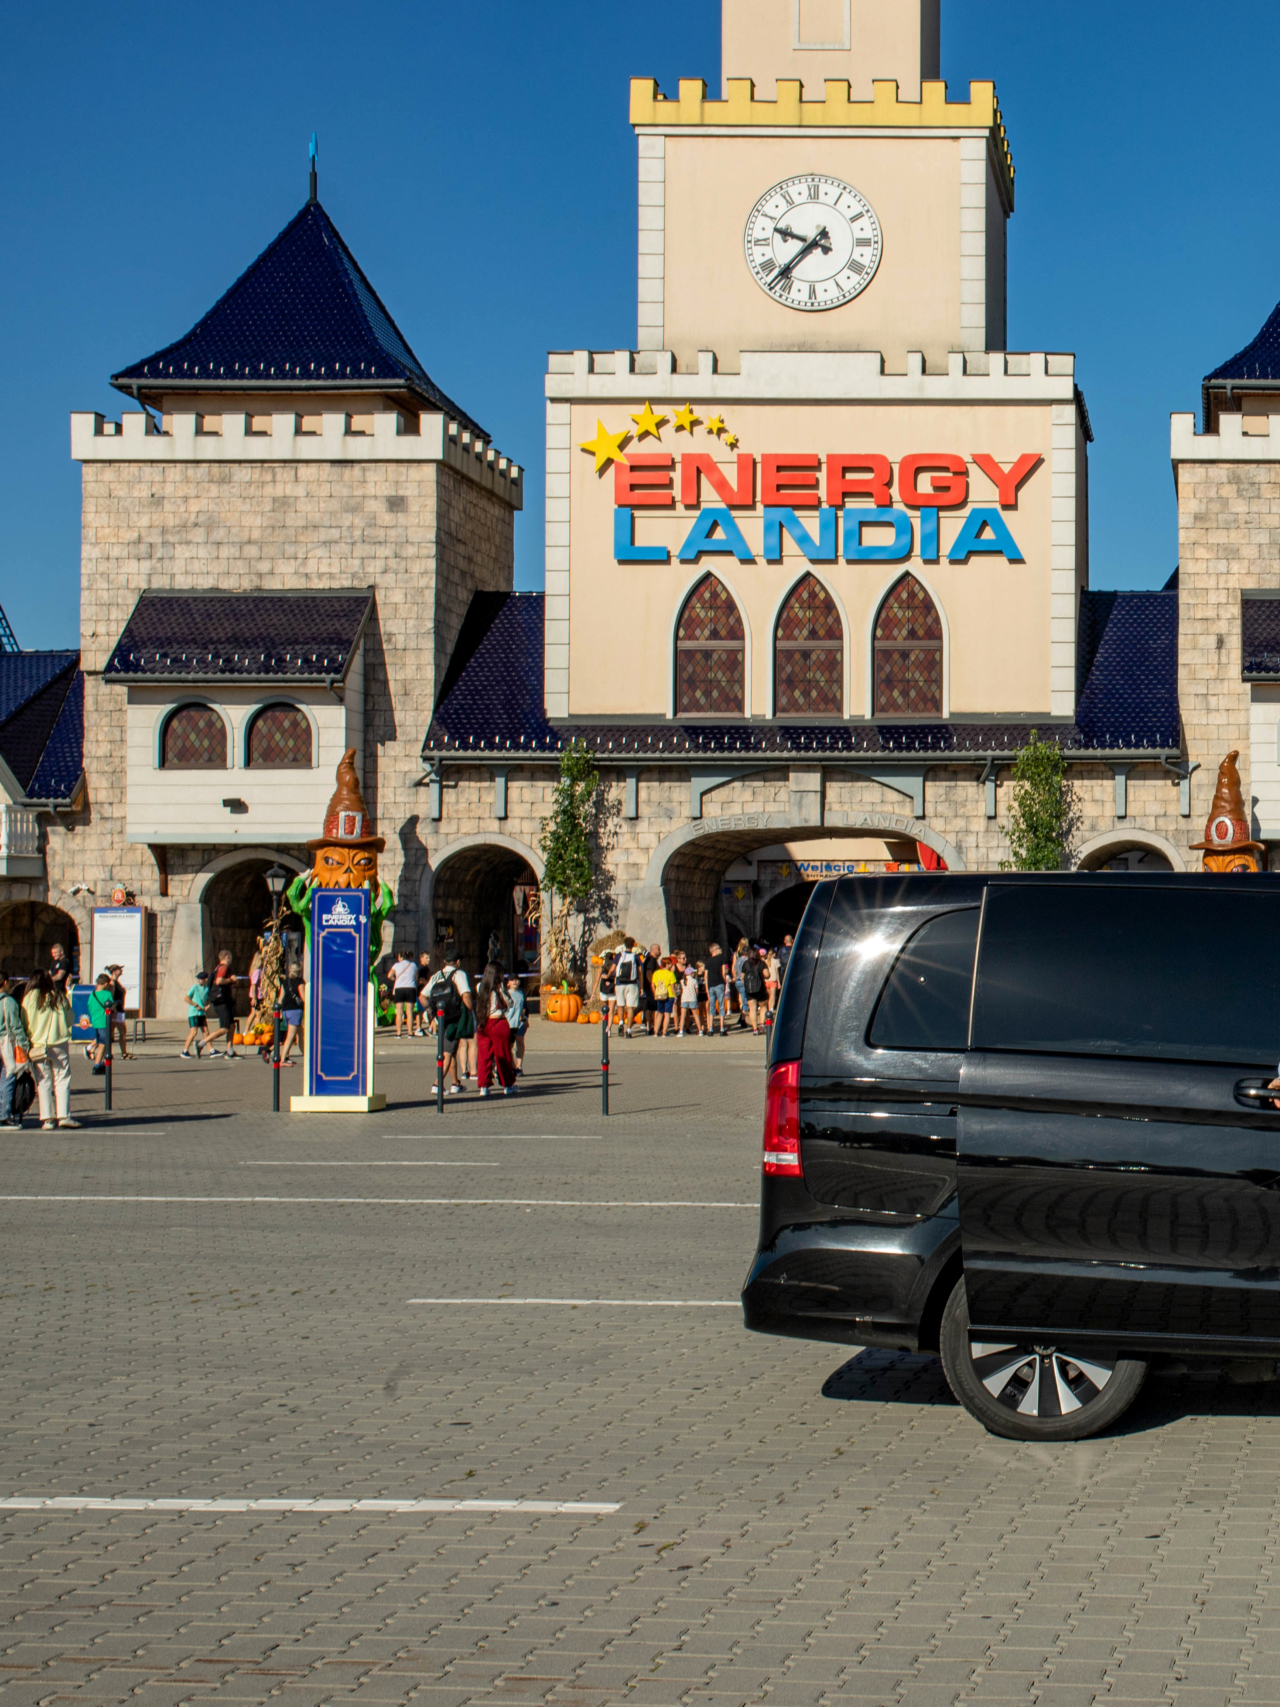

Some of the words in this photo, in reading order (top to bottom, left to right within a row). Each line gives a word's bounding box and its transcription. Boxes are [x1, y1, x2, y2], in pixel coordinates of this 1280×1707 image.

[806, 184, 820, 200] XII
[612, 452, 1044, 506] ENERGY
[612, 507, 1024, 561] LANDIA
[690, 813, 771, 836] ENERGY
[842, 812, 926, 841] LANDIA
